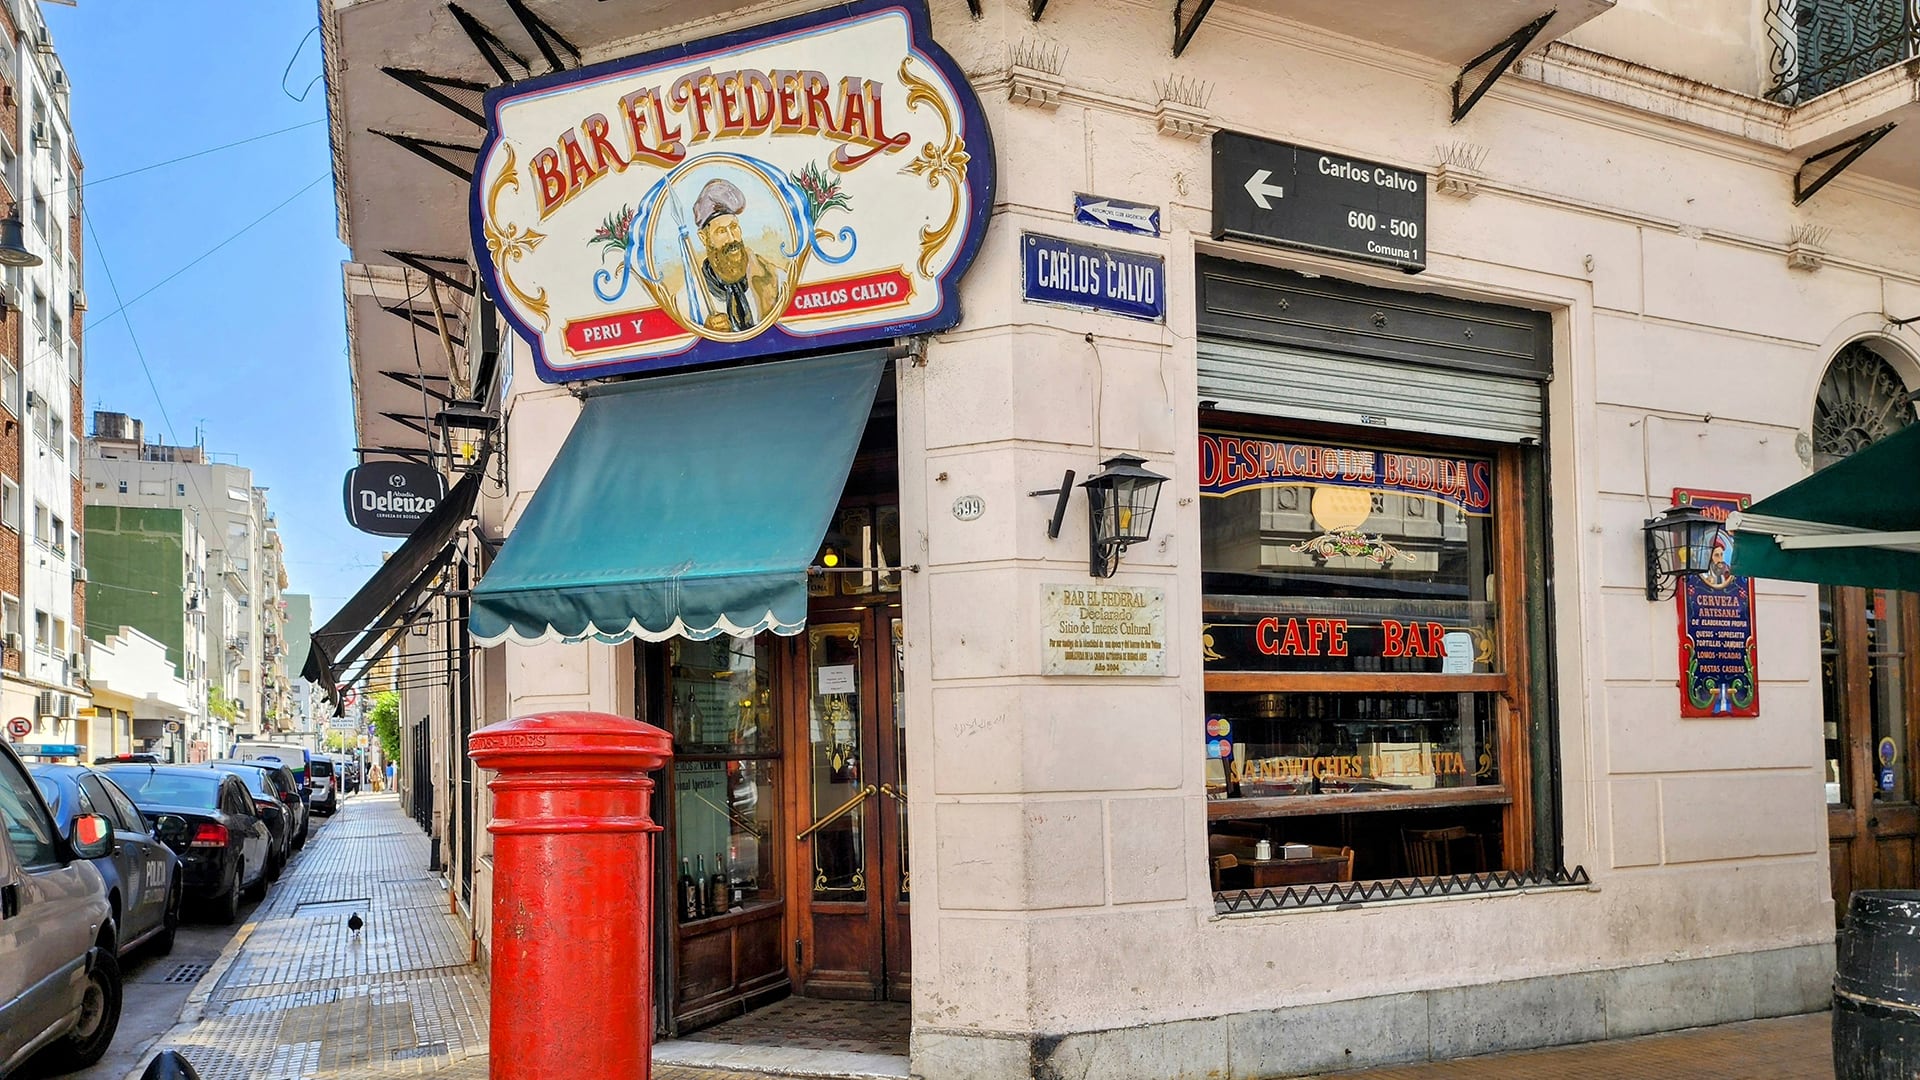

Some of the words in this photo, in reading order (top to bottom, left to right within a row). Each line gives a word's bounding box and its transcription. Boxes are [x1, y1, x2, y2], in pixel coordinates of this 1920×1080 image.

[528, 112, 630, 221] BAR
[617, 85, 687, 169] EL
[670, 66, 911, 172] FEDERAL
[1318, 156, 1370, 183] Carlos
[1374, 168, 1418, 193] Calvo
[1348, 211, 1376, 231] 600
[1390, 219, 1418, 239] 500
[1367, 240, 1409, 259] Comuna
[1413, 249, 1418, 260] 1
[1038, 248, 1099, 295] CARLOS
[1107, 259, 1154, 304] CALVO
[794, 286, 849, 311] CARLOS
[850, 280, 898, 303] CALVO
[583, 321, 622, 343] PERU
[632, 318, 644, 335] Y
[1199, 435, 1338, 488] DESPACHO
[1342, 449, 1376, 483] DE
[1383, 452, 1490, 508] BEBIDAS
[360, 489, 436, 513] Deleuze
[957, 499, 980, 516] 599
[1064, 590, 1085, 606] BAR
[1087, 591, 1100, 607] EL
[1101, 592, 1146, 608] FEDERAL
[1697, 595, 1740, 607] CERVEZA
[1080, 608, 1132, 621] Declarado
[1699, 608, 1740, 618] ARTESANAL
[1060, 621, 1078, 634] Sitio
[1080, 622, 1090, 634] de
[1120, 622, 1151, 635] Cultural
[1256, 617, 1348, 657] CAFE
[1382, 619, 1448, 658] BAR
[1700, 665, 1720, 673] PASTAS
[1722, 665, 1745, 673] CASERAS
[1230, 755, 1362, 783] SANDWICHES
